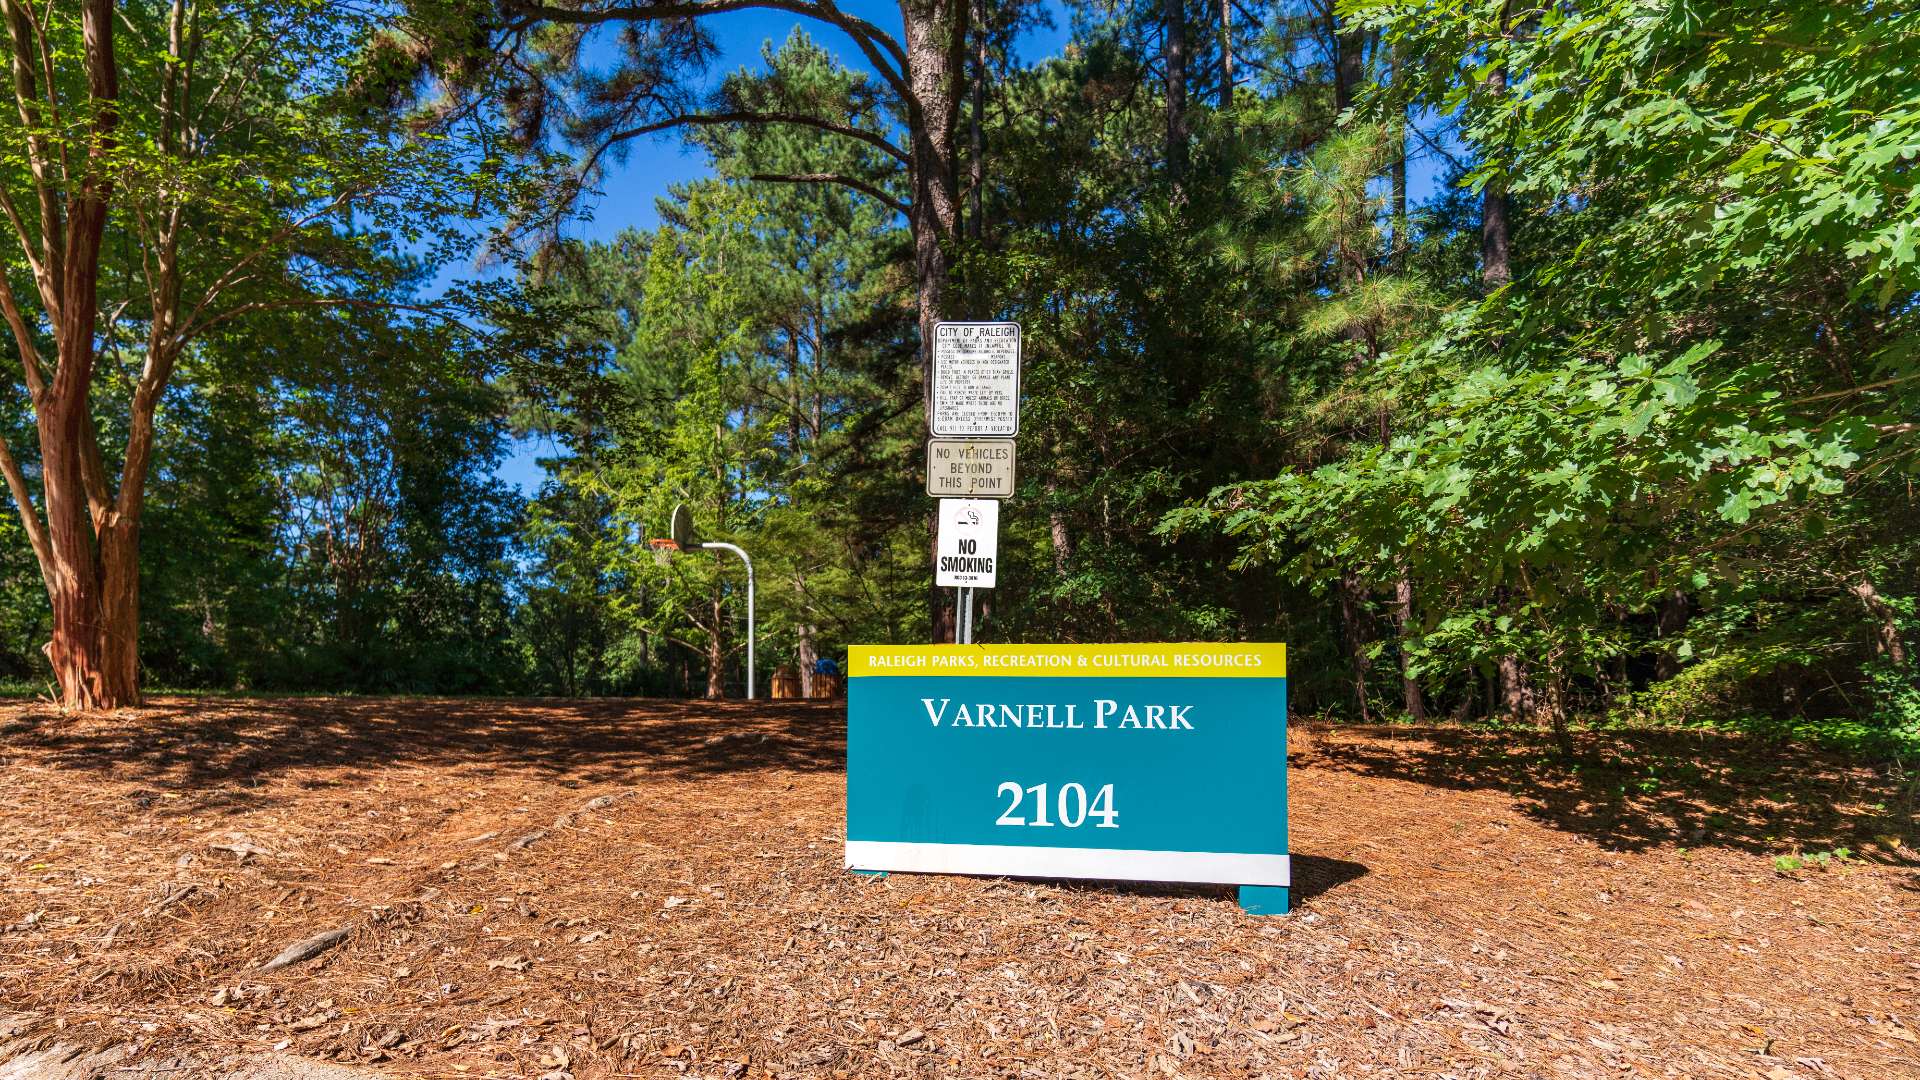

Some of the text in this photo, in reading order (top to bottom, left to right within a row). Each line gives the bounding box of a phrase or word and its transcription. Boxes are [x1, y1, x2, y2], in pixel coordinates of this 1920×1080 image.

[940, 327, 1015, 337] CITY OF RALEIGH
[936, 448, 1008, 460] NO VEHICLES
[950, 462, 992, 474] BEYOND
[939, 476, 1003, 489] THIS POINT
[958, 539, 977, 555] NO
[940, 556, 993, 574] SMOKING
[869, 655, 1262, 669] RALEIGH PARKS, RECREATION & CULTURAL RESOURCES
[920, 698, 1195, 730] VARNELL PARK
[995, 781, 1120, 829] 2104
